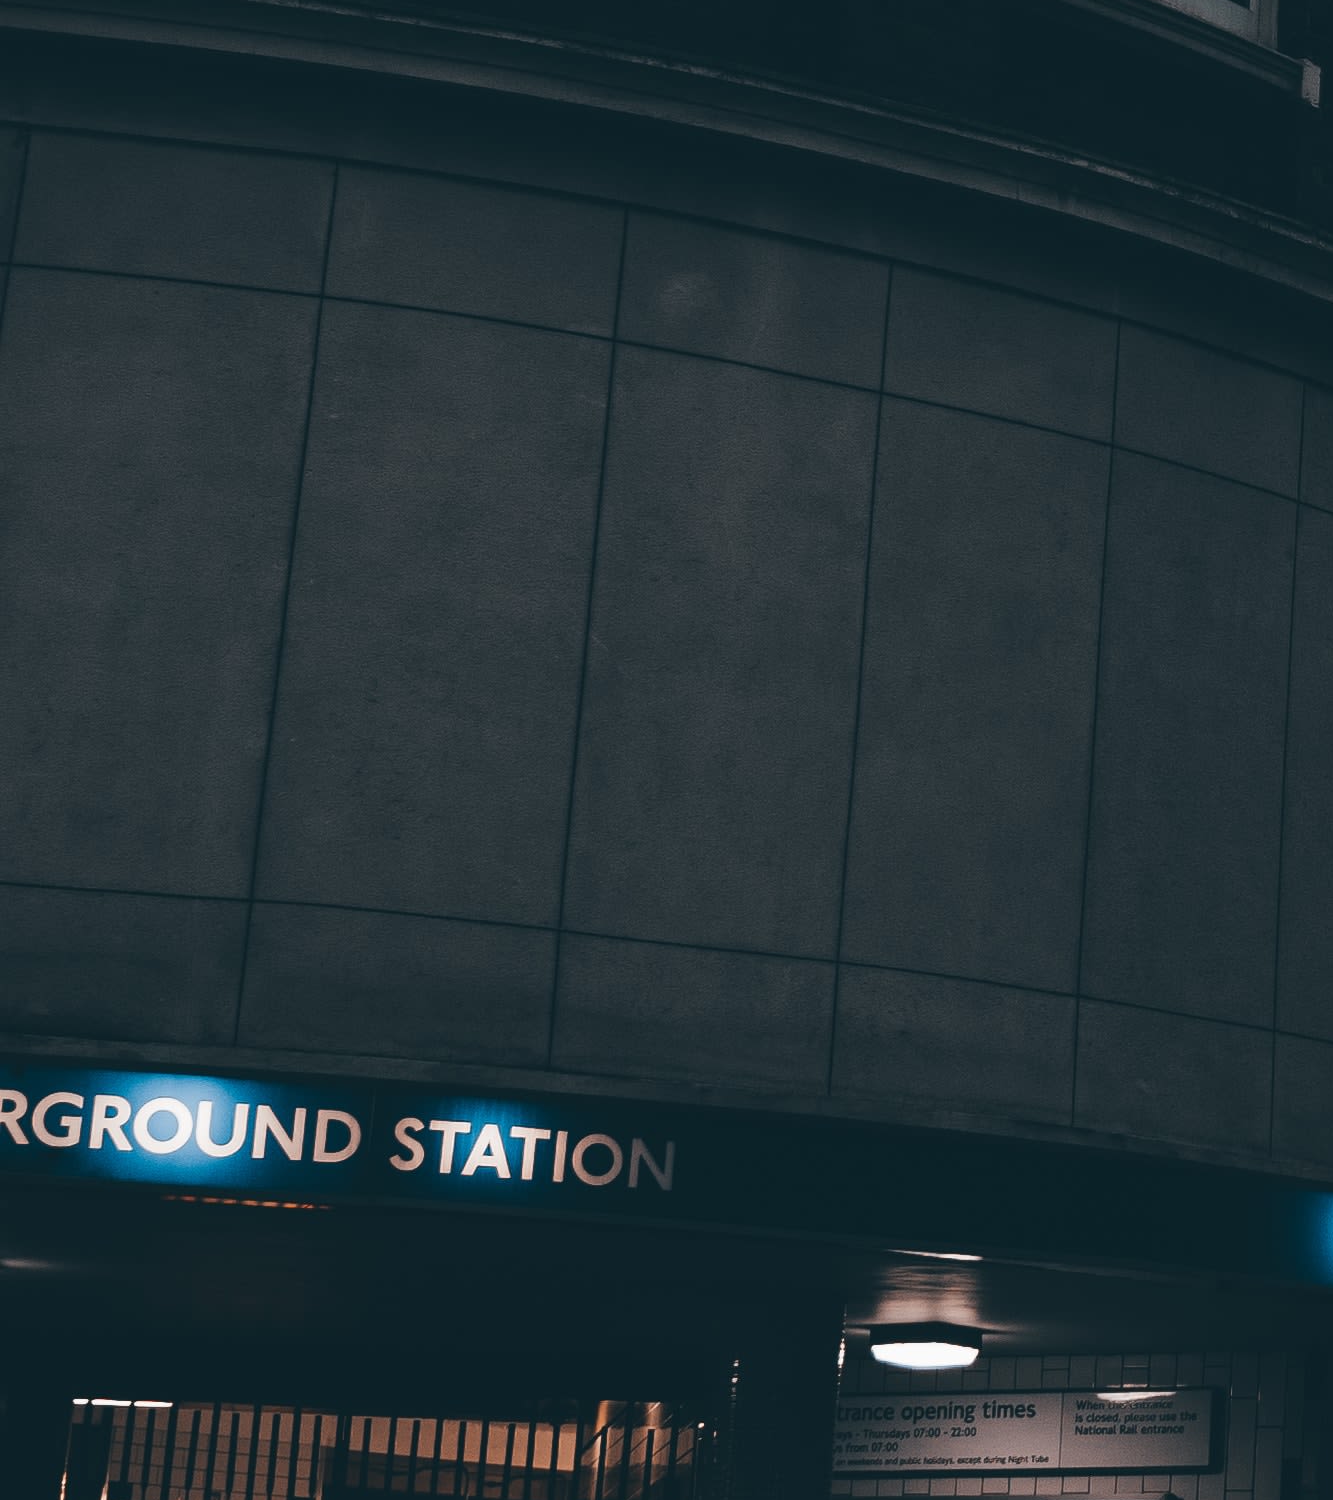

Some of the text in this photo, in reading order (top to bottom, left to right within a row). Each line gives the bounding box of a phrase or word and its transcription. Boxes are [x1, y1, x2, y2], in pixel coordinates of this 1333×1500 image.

[388, 1116, 677, 1192] STATION
[1076, 1400, 1105, 1410] When
[901, 1401, 976, 1424] opening
[983, 1400, 1036, 1418] times
[1075, 1412, 1083, 1422] is
[1124, 1412, 1156, 1424] please
[1160, 1414, 1177, 1422] use
[1180, 1411, 1197, 1421] the
[864, 1428, 911, 1440] Thursdays
[913, 1427, 941, 1438] 07:00
[951, 1427, 977, 1437] 22:00
[1075, 1424, 1184, 1435] National Rail entrance
[846, 1442, 868, 1452] from
[871, 1442, 898, 1452] 07:00
